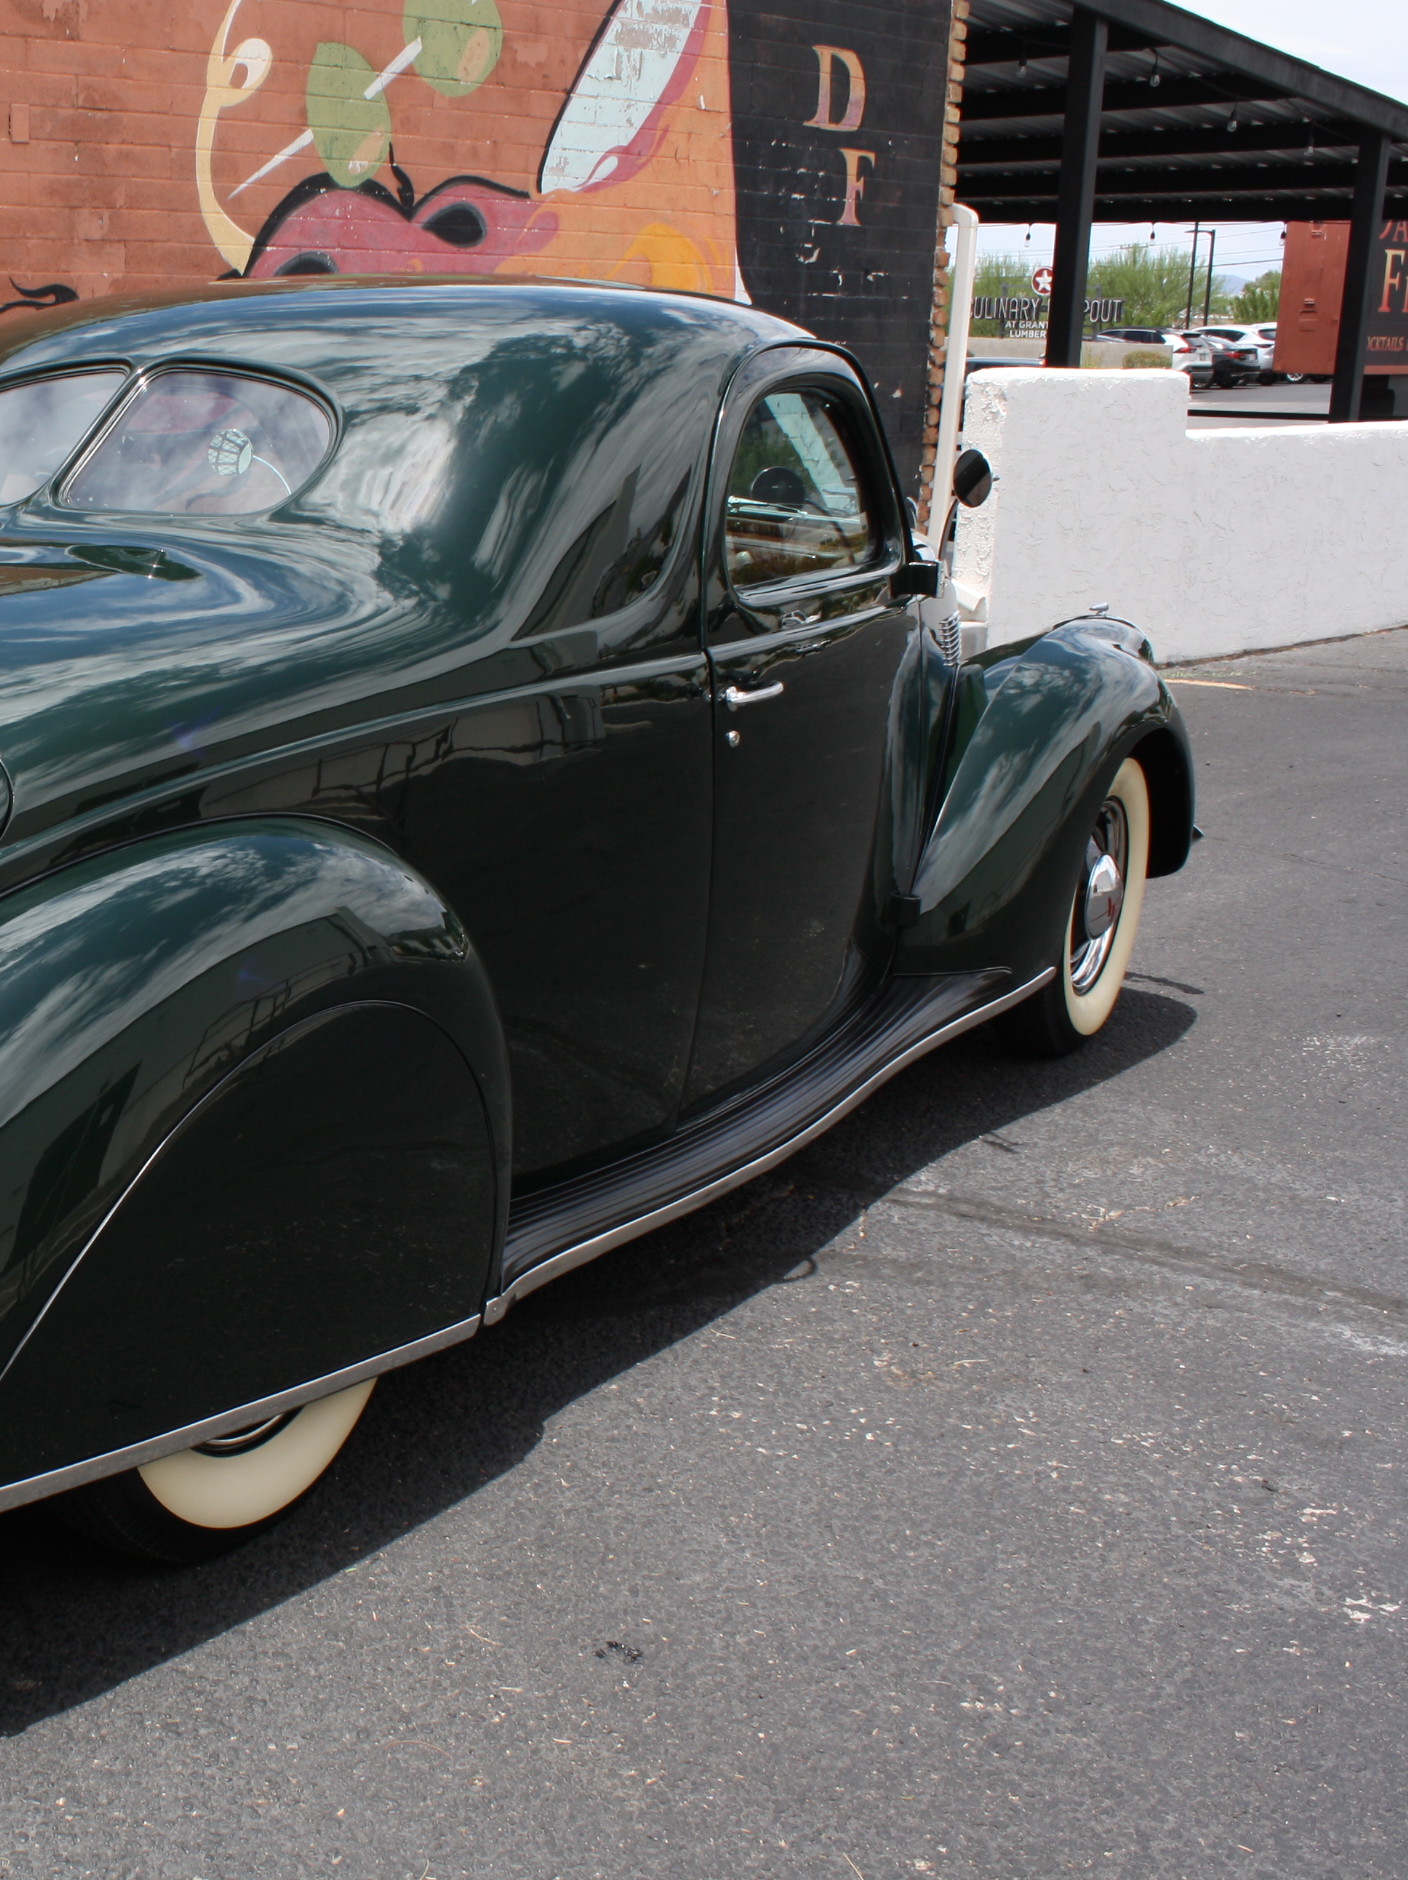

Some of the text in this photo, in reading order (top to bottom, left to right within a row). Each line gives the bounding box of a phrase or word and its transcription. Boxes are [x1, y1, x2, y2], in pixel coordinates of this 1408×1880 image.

[803, 44, 866, 131] D
[836, 148, 876, 226] F
[970, 296, 1040, 320] ULINARY
[1009, 330, 1047, 338] LUMBER
